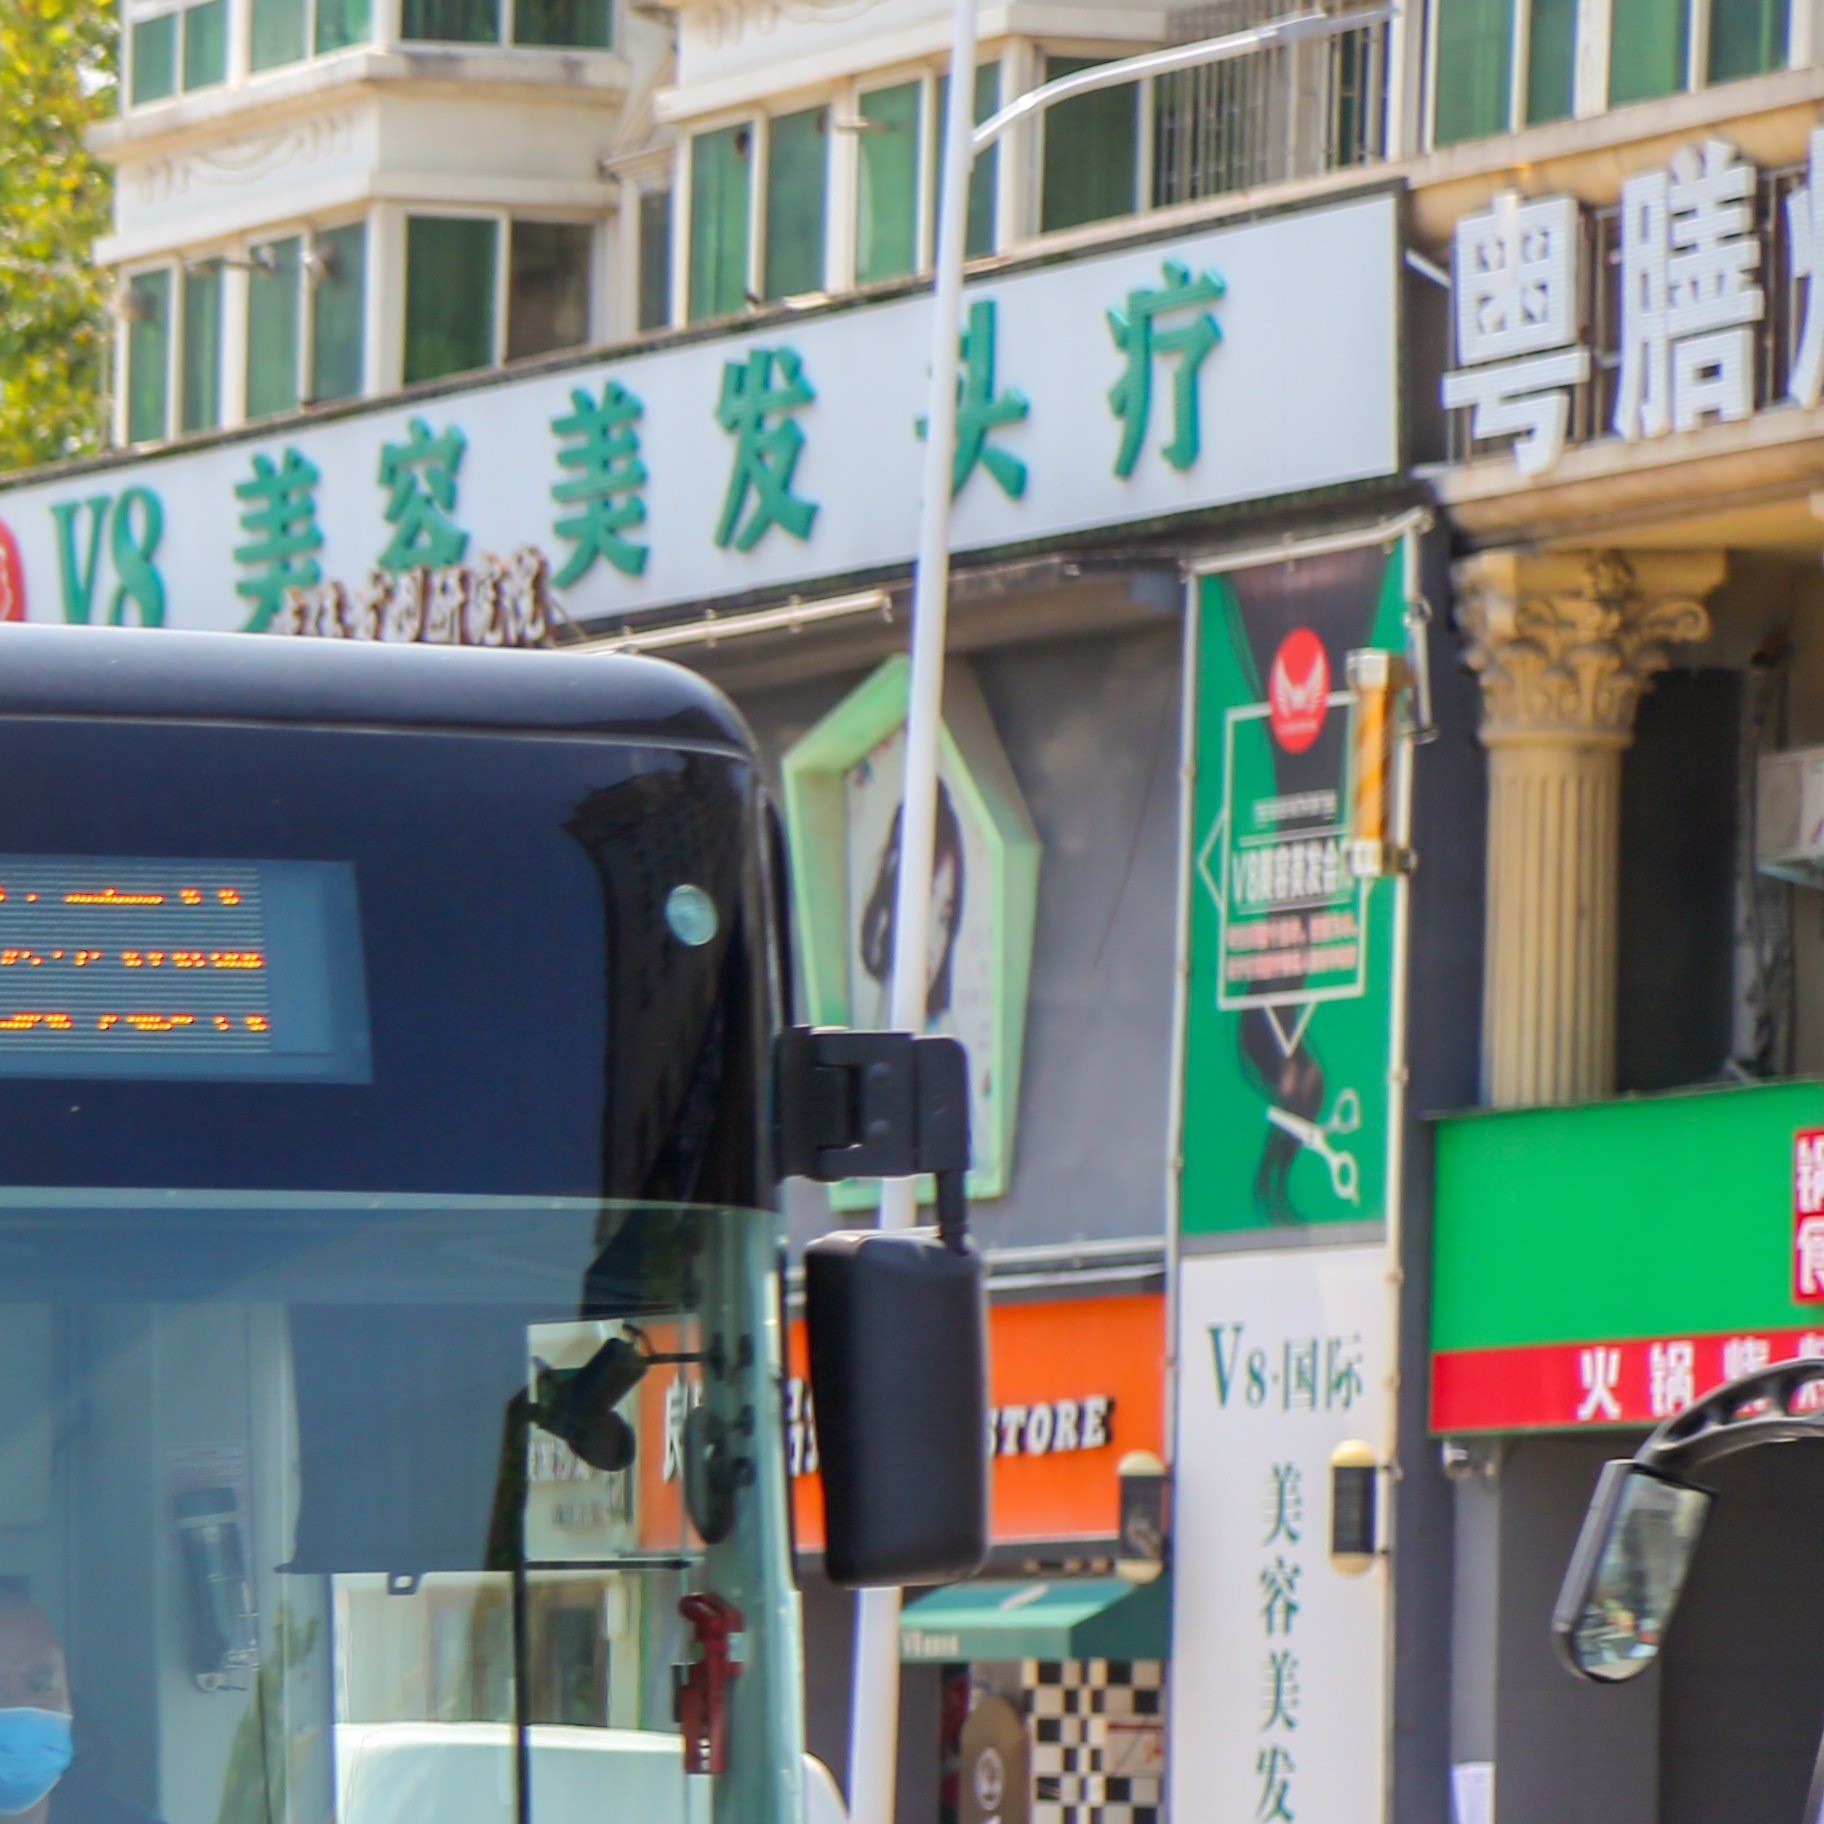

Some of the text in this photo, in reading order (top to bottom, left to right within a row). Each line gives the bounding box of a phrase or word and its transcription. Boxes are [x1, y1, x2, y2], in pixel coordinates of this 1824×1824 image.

[50, 260, 1226, 632] V8 美容美发头疗
[1442, 126, 1824, 477] 粤膳
